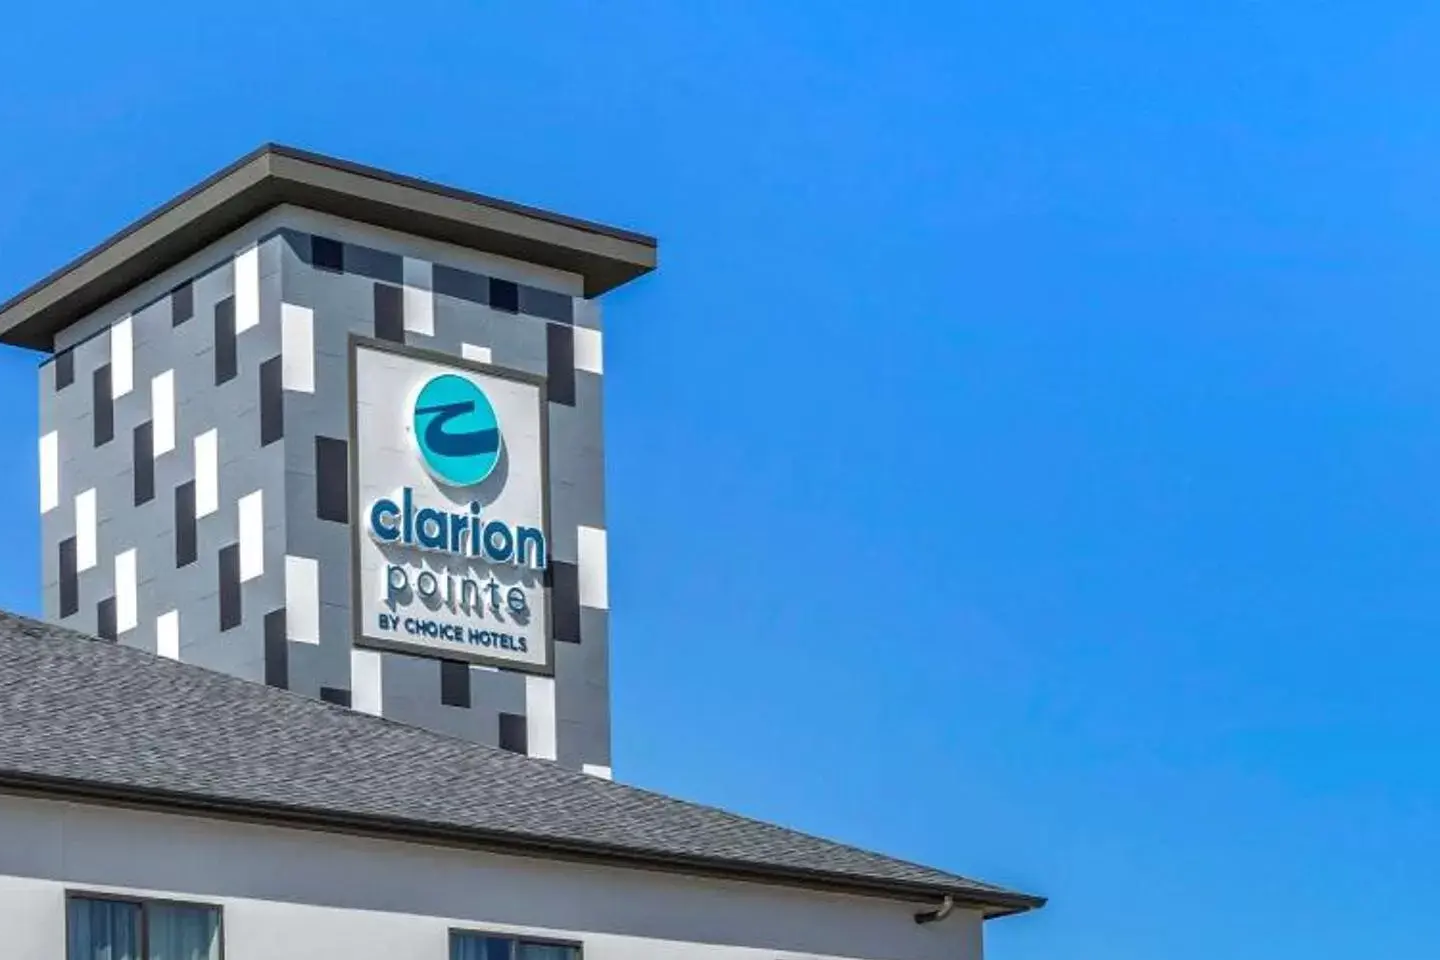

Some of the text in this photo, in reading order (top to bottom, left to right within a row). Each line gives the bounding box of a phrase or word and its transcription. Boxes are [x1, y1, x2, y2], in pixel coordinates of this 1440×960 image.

[369, 486, 546, 568] clarion
[386, 564, 526, 612] pointe
[378, 613, 528, 653] BY CHOICE HOTELS
